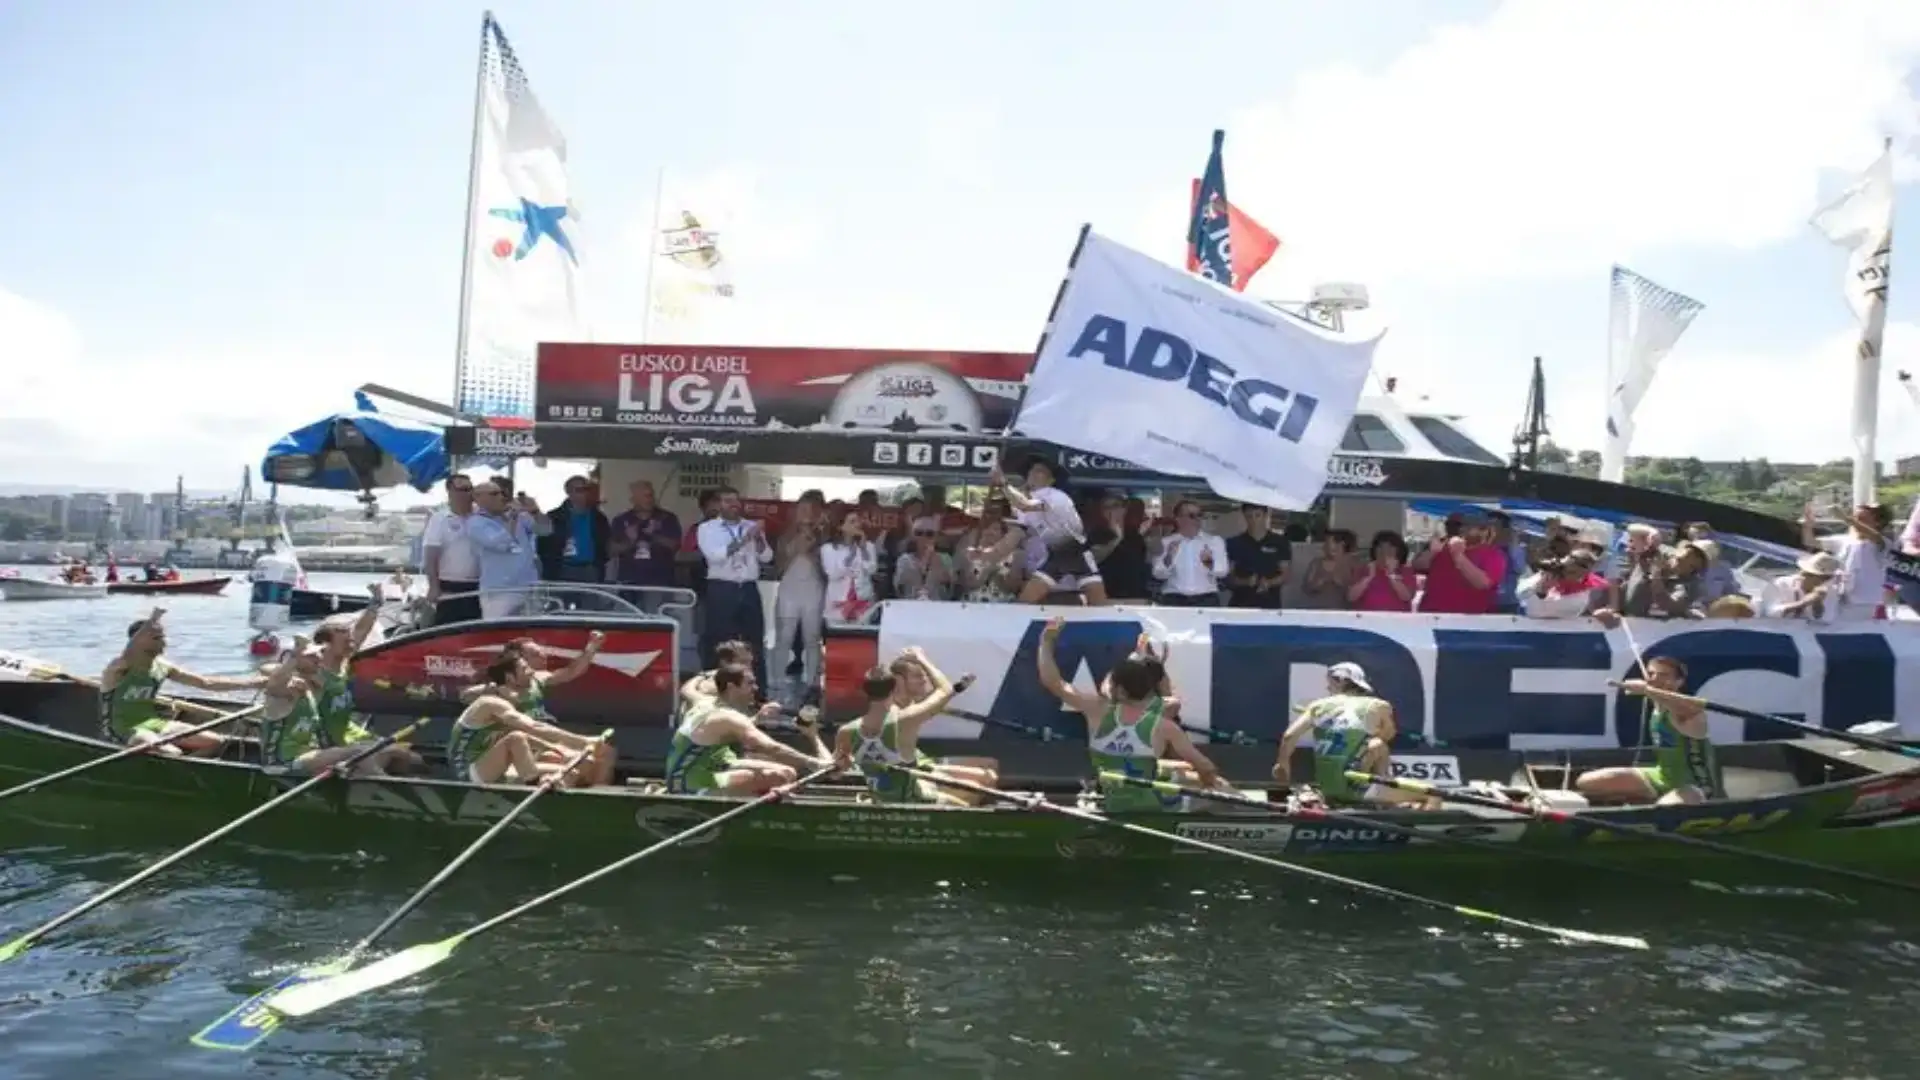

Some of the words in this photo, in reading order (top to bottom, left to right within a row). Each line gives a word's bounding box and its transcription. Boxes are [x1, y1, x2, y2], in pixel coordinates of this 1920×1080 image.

[620, 354, 684, 372] EUSKO
[692, 356, 751, 374] LABEL
[1068, 313, 1319, 443] ADEGI
[616, 373, 757, 414] LIGA
[615, 412, 674, 424] CORONA
[677, 414, 757, 425] CAIXABANK
[980, 618, 1894, 750] ADEGI
